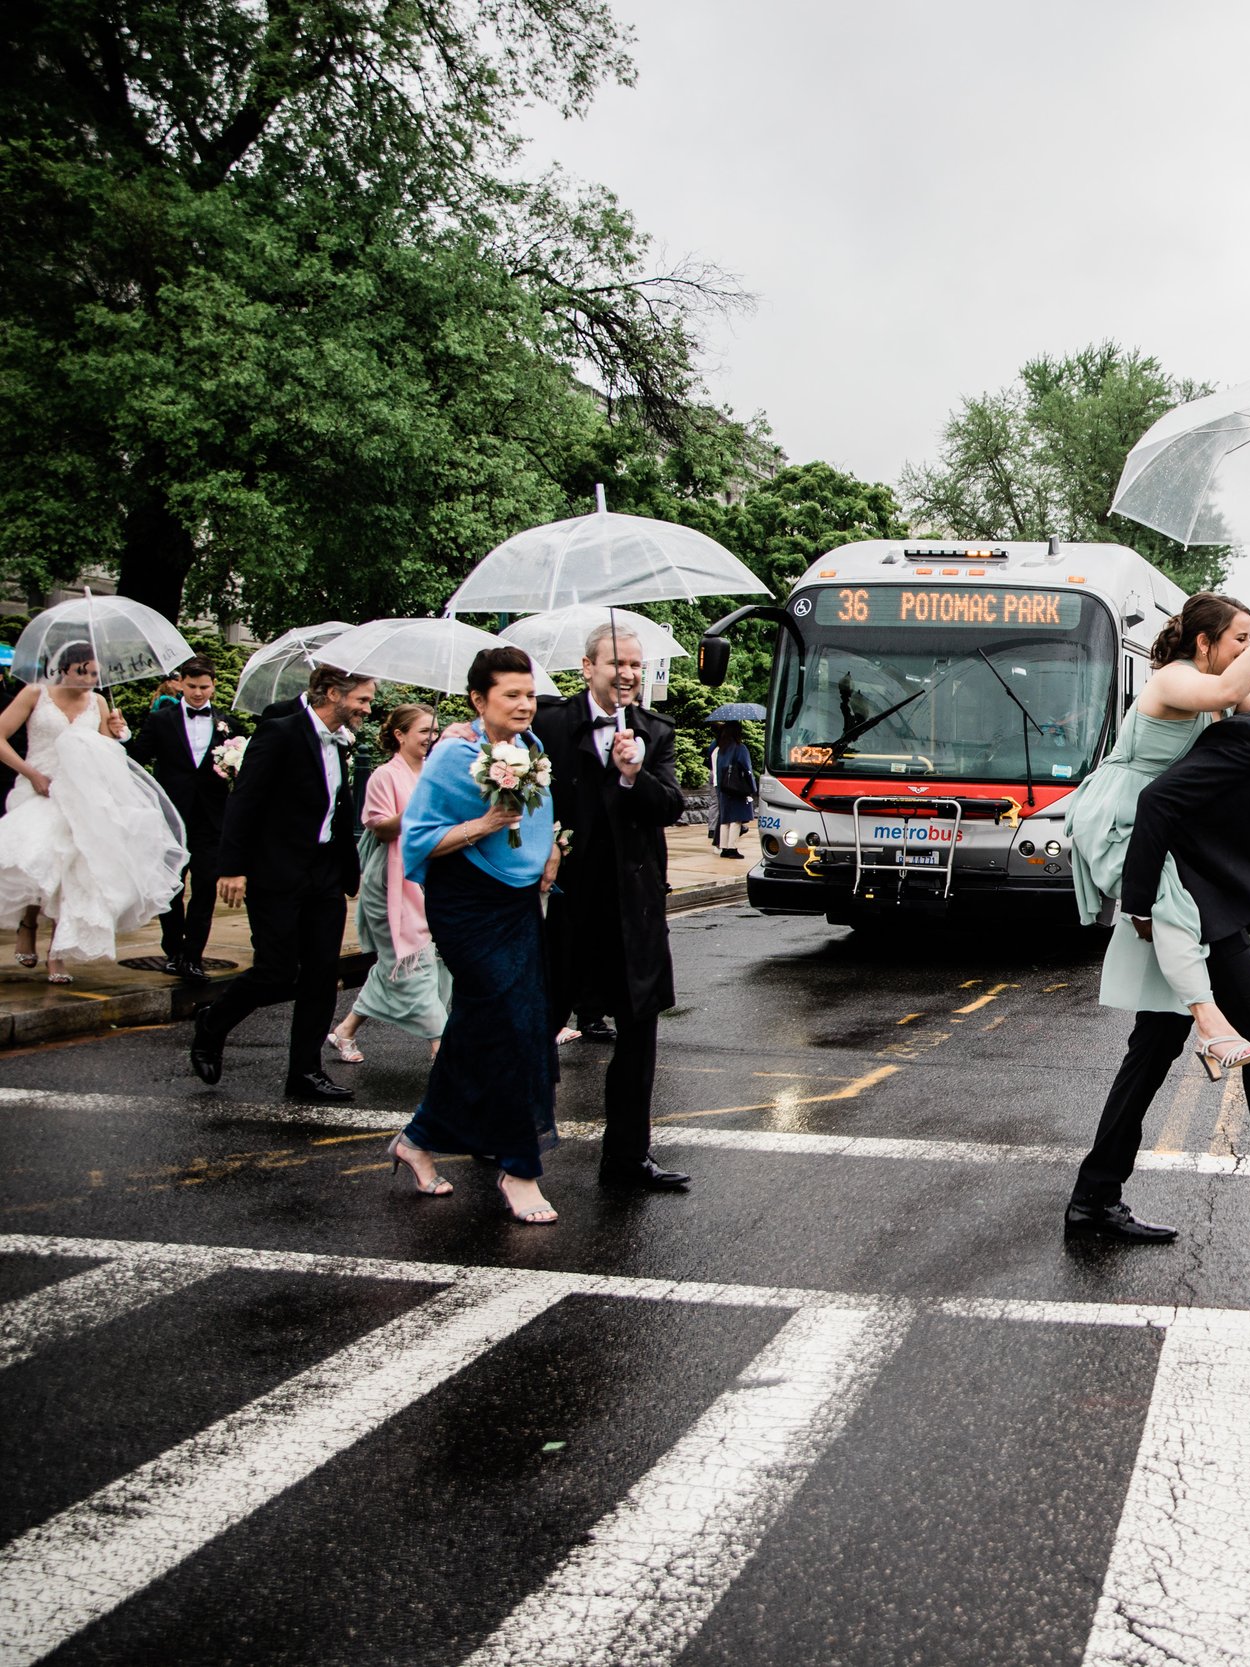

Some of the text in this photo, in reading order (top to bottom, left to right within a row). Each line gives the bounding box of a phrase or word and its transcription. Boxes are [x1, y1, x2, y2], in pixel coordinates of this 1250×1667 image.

[838, 589, 1061, 624] 36 POTOMAC PARK
[874, 825, 964, 843] metrobus
